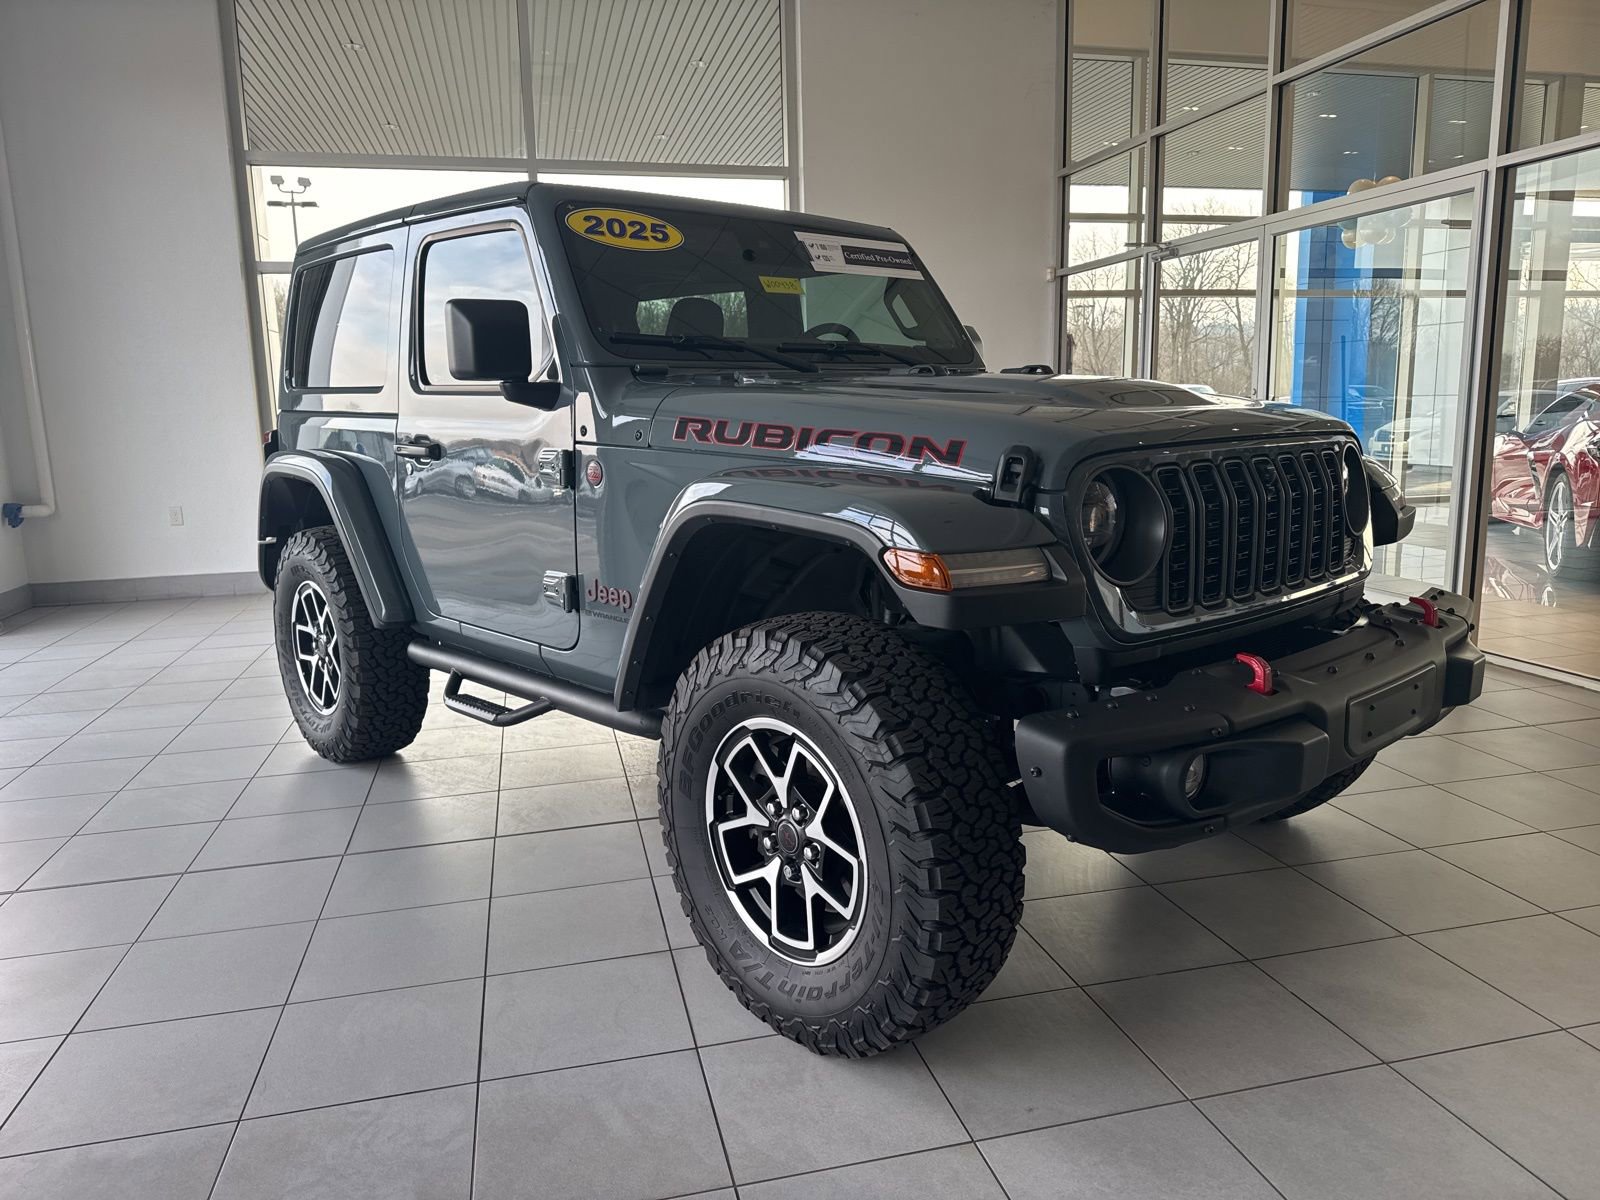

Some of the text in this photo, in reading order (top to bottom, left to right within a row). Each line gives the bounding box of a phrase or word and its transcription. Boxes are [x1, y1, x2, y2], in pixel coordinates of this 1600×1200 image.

[583, 215, 670, 243] 2025
[844, 251, 875, 262] Certified
[875, 254, 912, 265] Pre-Owned
[673, 416, 967, 467] RUBICON
[586, 579, 633, 613] Jeep
[592, 610, 631, 624] WRANGLE
